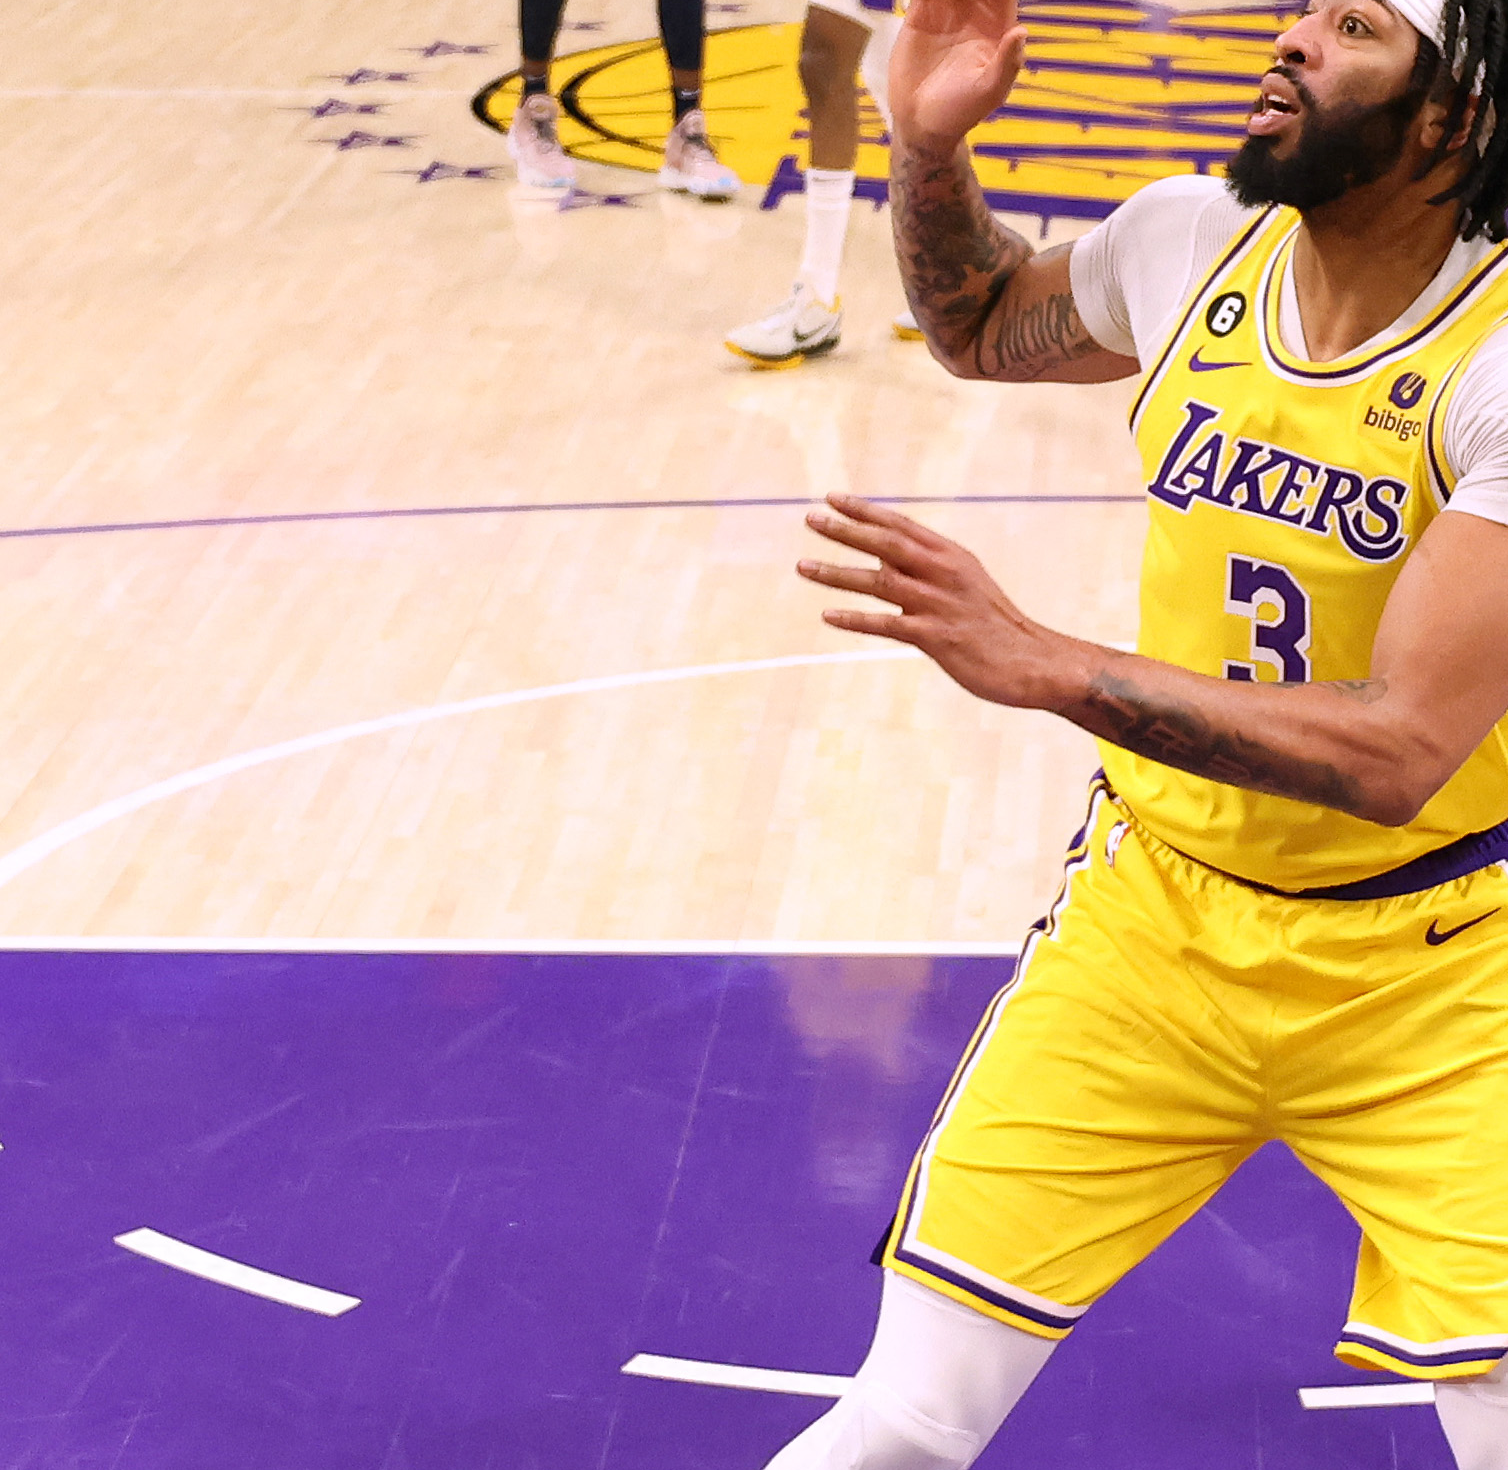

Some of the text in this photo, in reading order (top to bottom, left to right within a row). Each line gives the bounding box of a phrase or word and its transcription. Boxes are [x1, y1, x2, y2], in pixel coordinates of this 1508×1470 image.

[1211, 295, 1243, 334] 6
[1363, 405, 1422, 442] bibigo
[1147, 398, 1411, 563] LAKERS
[1224, 553, 1312, 683] 3
